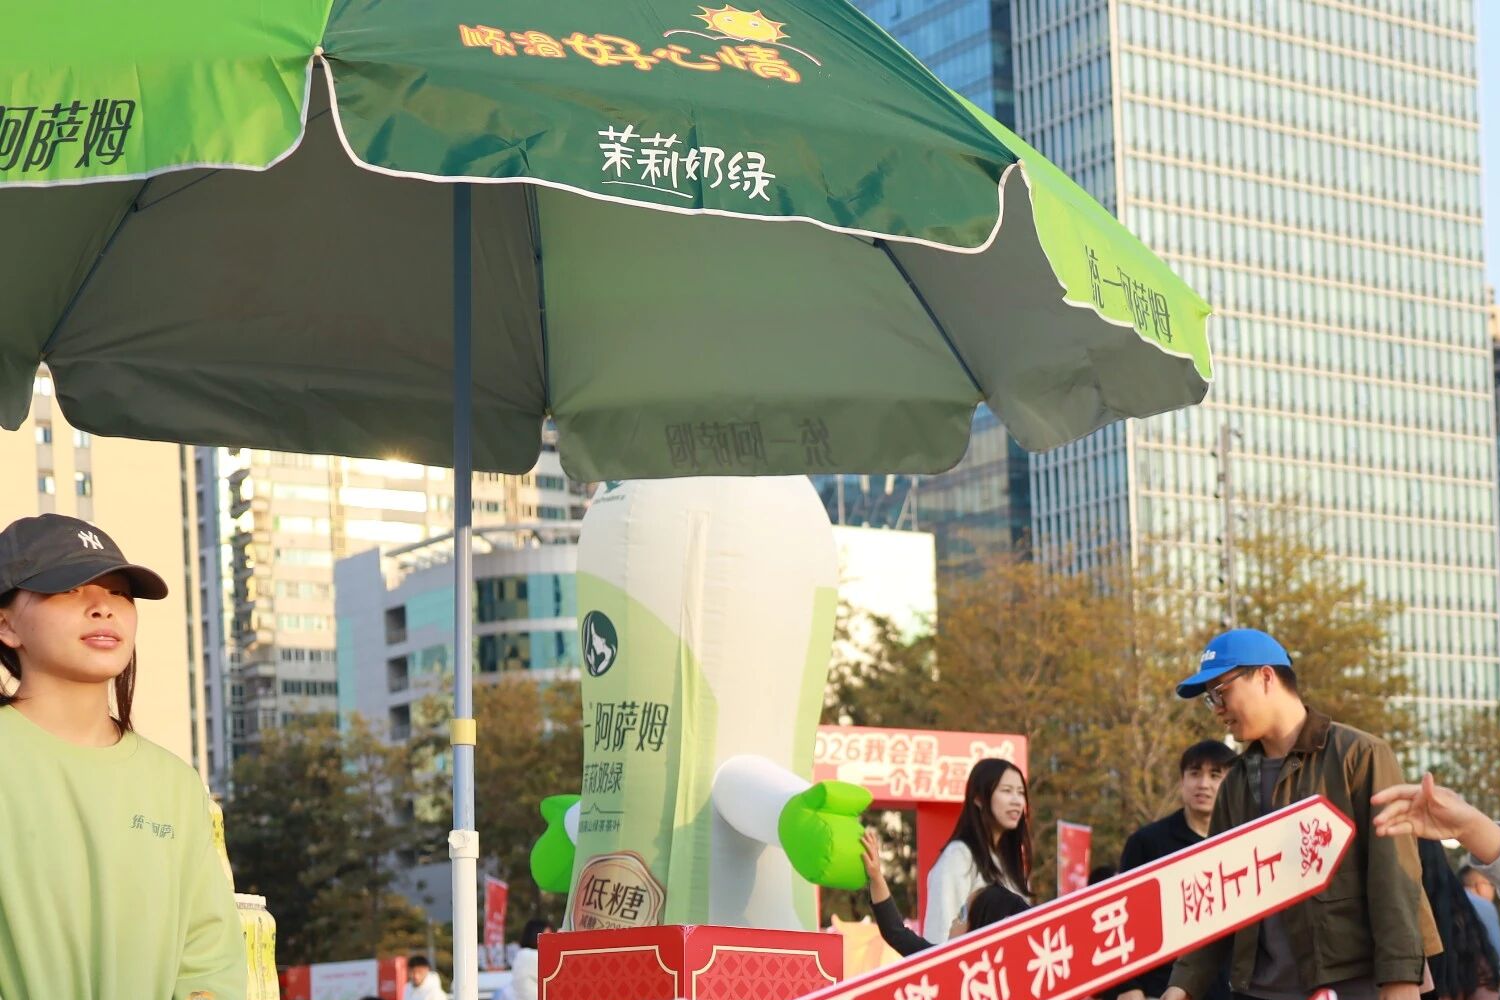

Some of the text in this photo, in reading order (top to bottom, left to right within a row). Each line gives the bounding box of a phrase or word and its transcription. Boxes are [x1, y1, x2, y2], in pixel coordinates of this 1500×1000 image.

[458, 24, 802, 84] 顺滑好心情
[597, 124, 776, 202] 茉莉奶绿
[1084, 244, 1173, 344] 统一阿萨姆
[582, 875, 647, 922] 低糖
[1180, 845, 1283, 925] 上上签
